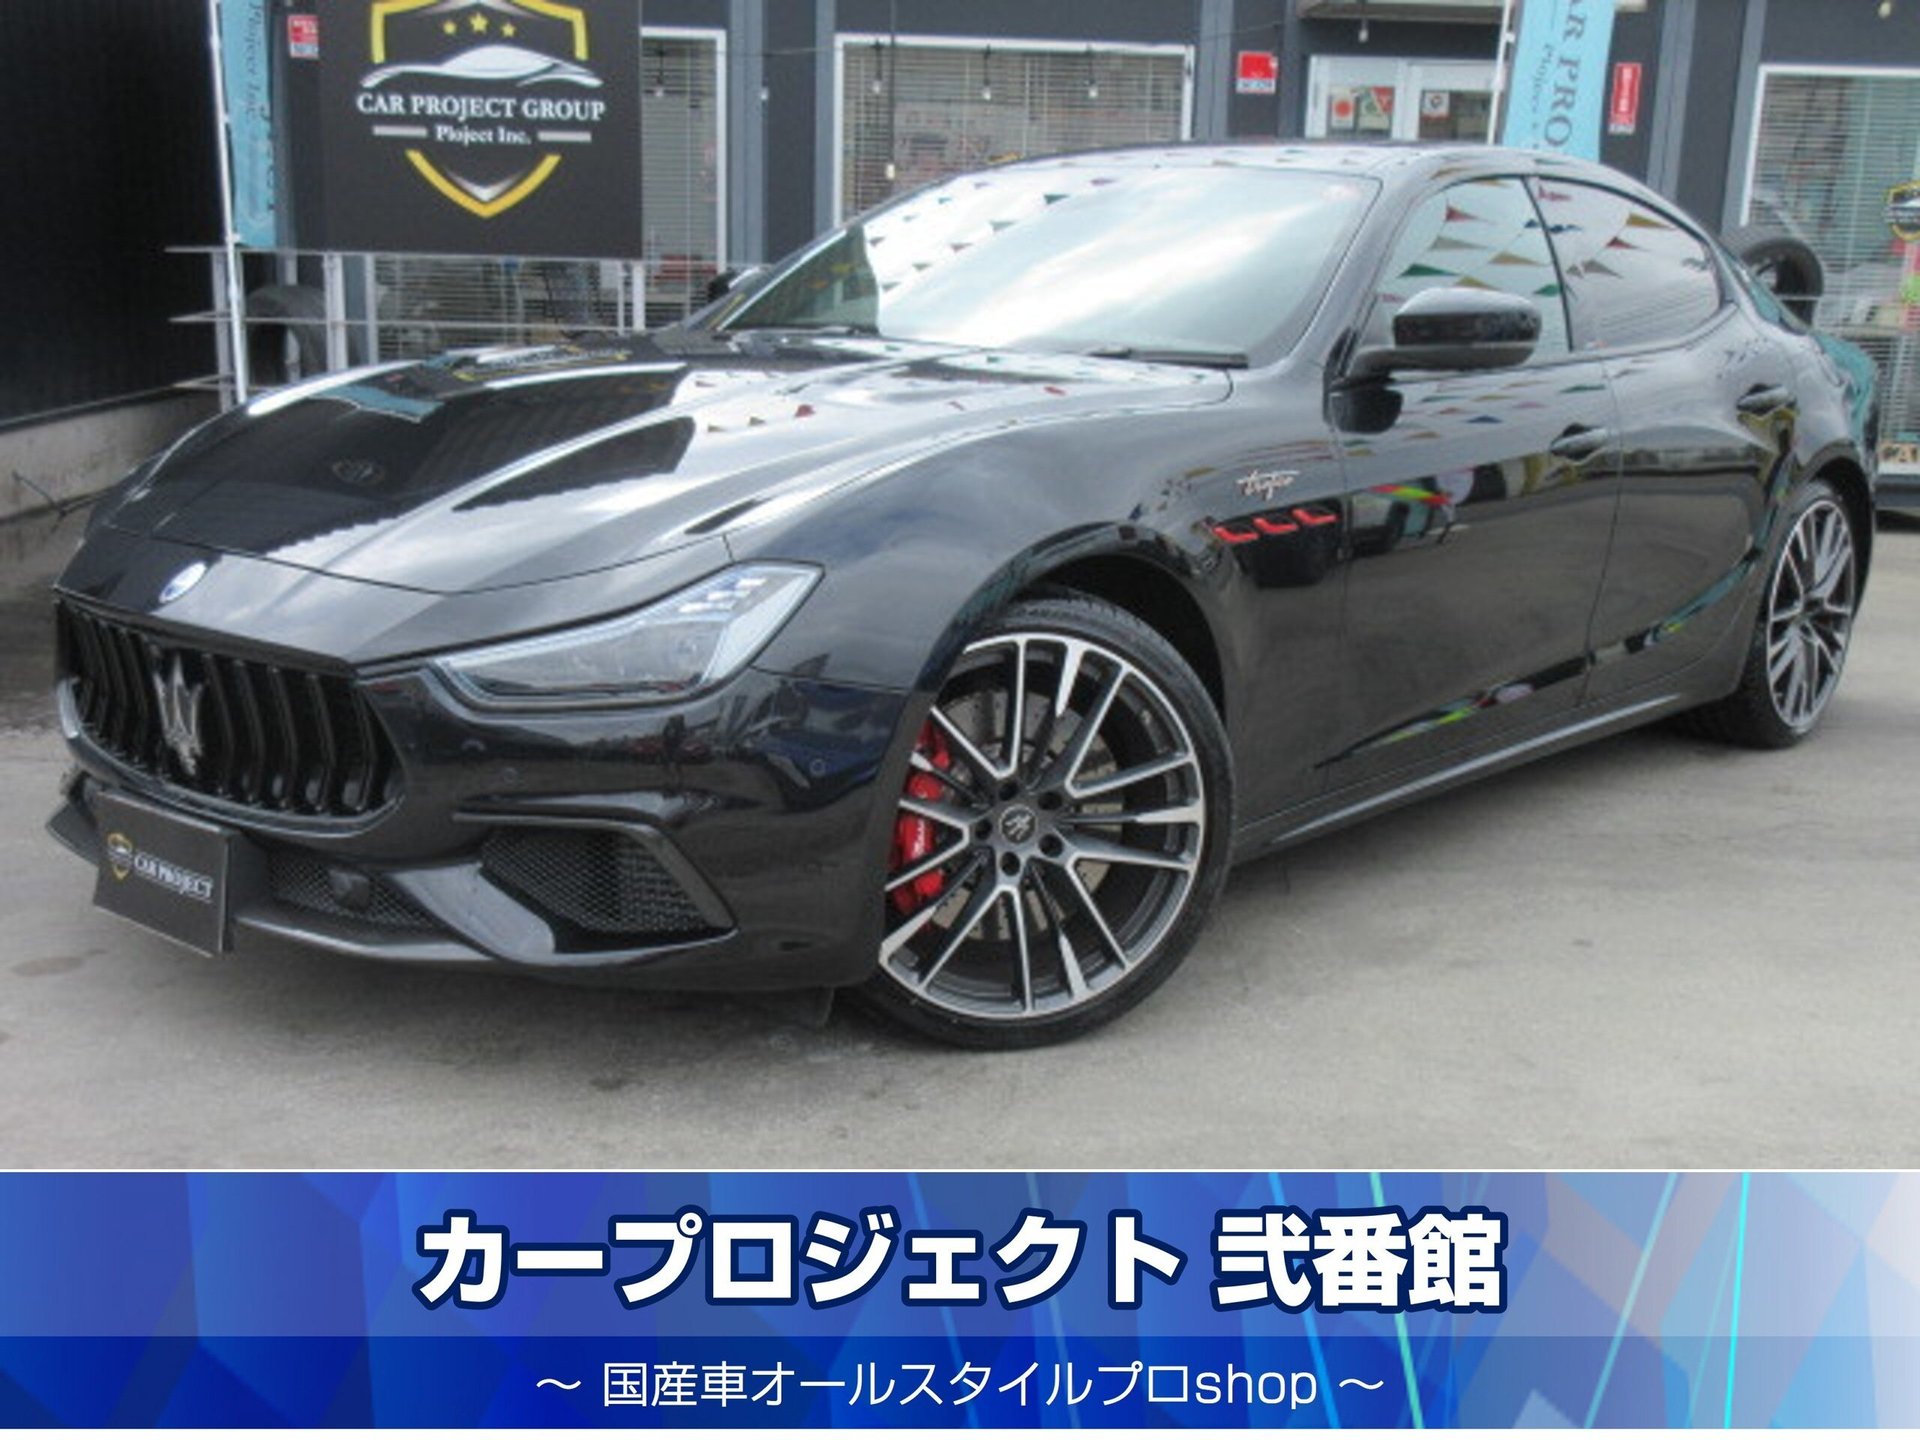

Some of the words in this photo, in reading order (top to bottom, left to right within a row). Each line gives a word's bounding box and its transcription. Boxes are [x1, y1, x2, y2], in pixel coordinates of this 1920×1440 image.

[356, 93, 405, 115] CAR
[411, 94, 517, 122] PROJECT
[521, 98, 606, 121] GROUP
[497, 127, 532, 145] Inc.
